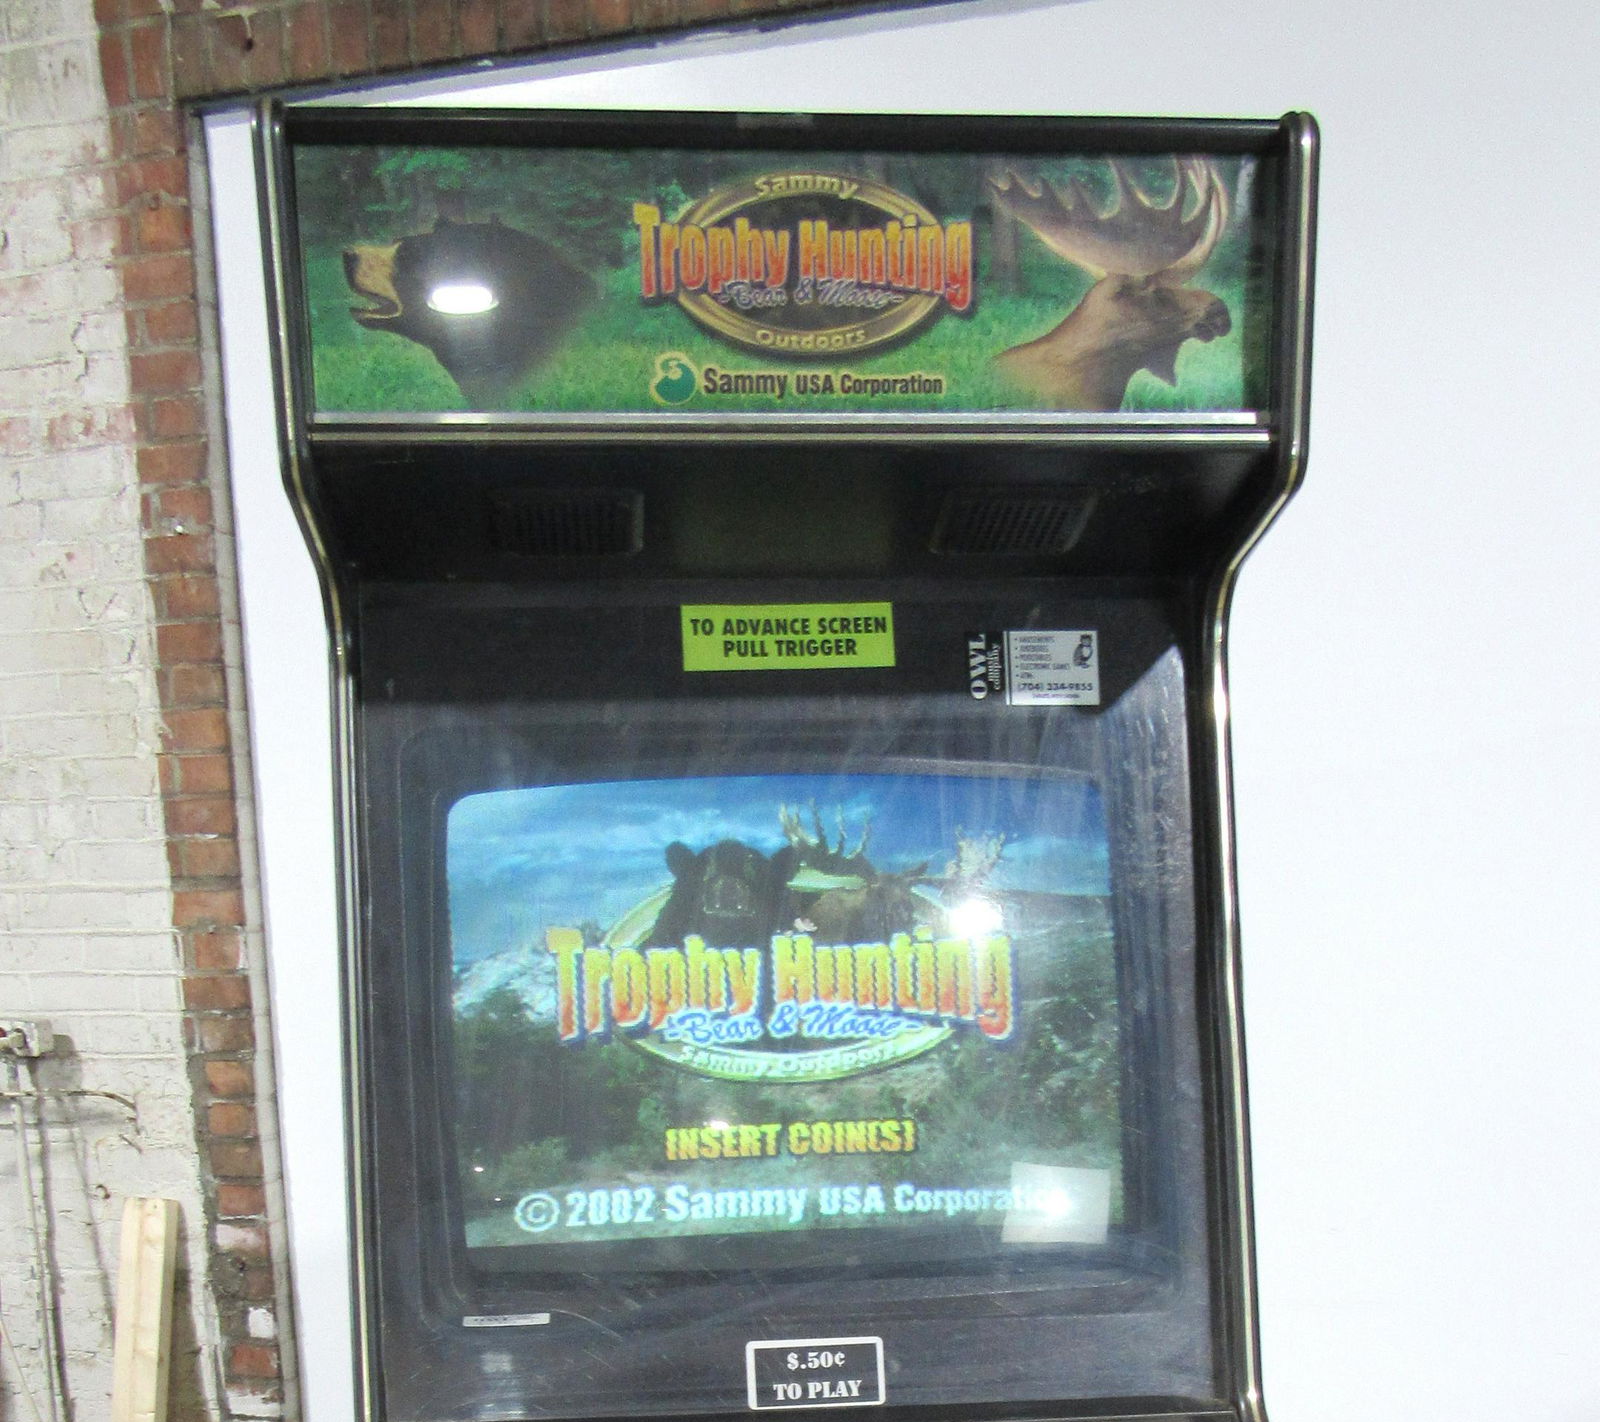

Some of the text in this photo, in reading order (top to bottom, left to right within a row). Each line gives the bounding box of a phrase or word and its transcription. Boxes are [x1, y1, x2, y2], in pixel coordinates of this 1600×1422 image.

[754, 175, 859, 200] Sammy
[633, 201, 973, 311] Trophy Hunting
[756, 329, 865, 349] Outdoors
[703, 368, 943, 398] Sammy USA Corporation
[690, 616, 887, 636] TO ADVANCE SCREEN
[723, 638, 857, 658] PULL TRIGGER
[967, 633, 988, 699] OWL
[546, 926, 1016, 1041] Trophy Hunting
[769, 1000, 798, 1038] &
[665, 1123, 782, 1160] INSERT
[664, 1184, 808, 1223] Sammy
[819, 1185, 886, 1215] USA
[787, 1351, 846, 1371] $.50¢
[773, 1380, 862, 1400] TO PLAY
